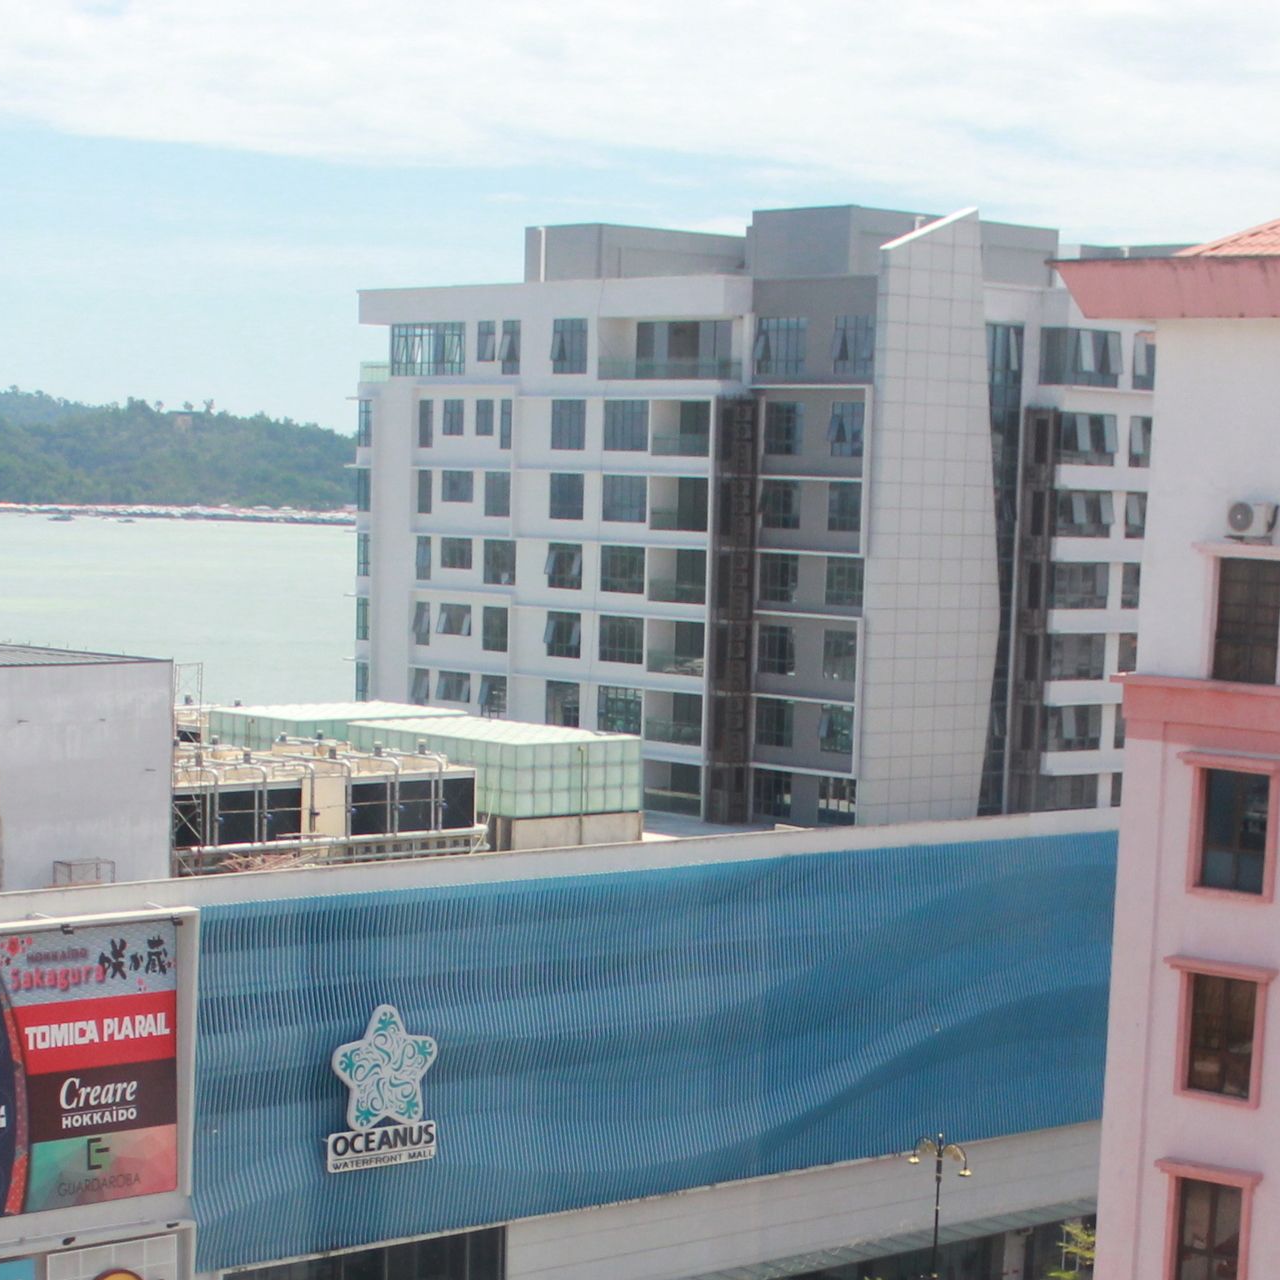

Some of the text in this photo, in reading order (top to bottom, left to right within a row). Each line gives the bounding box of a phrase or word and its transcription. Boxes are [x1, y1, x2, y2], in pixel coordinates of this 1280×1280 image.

[10, 964, 106, 991] Sakagura
[25, 1012, 170, 1050] TOMICA PLARAIL
[59, 1077, 137, 1110] Creare
[332, 1123, 435, 1156] OCEANUS
[332, 1149, 434, 1170] WATERFRONT MALL
[56, 1173, 141, 1197] GUARDAROBA
